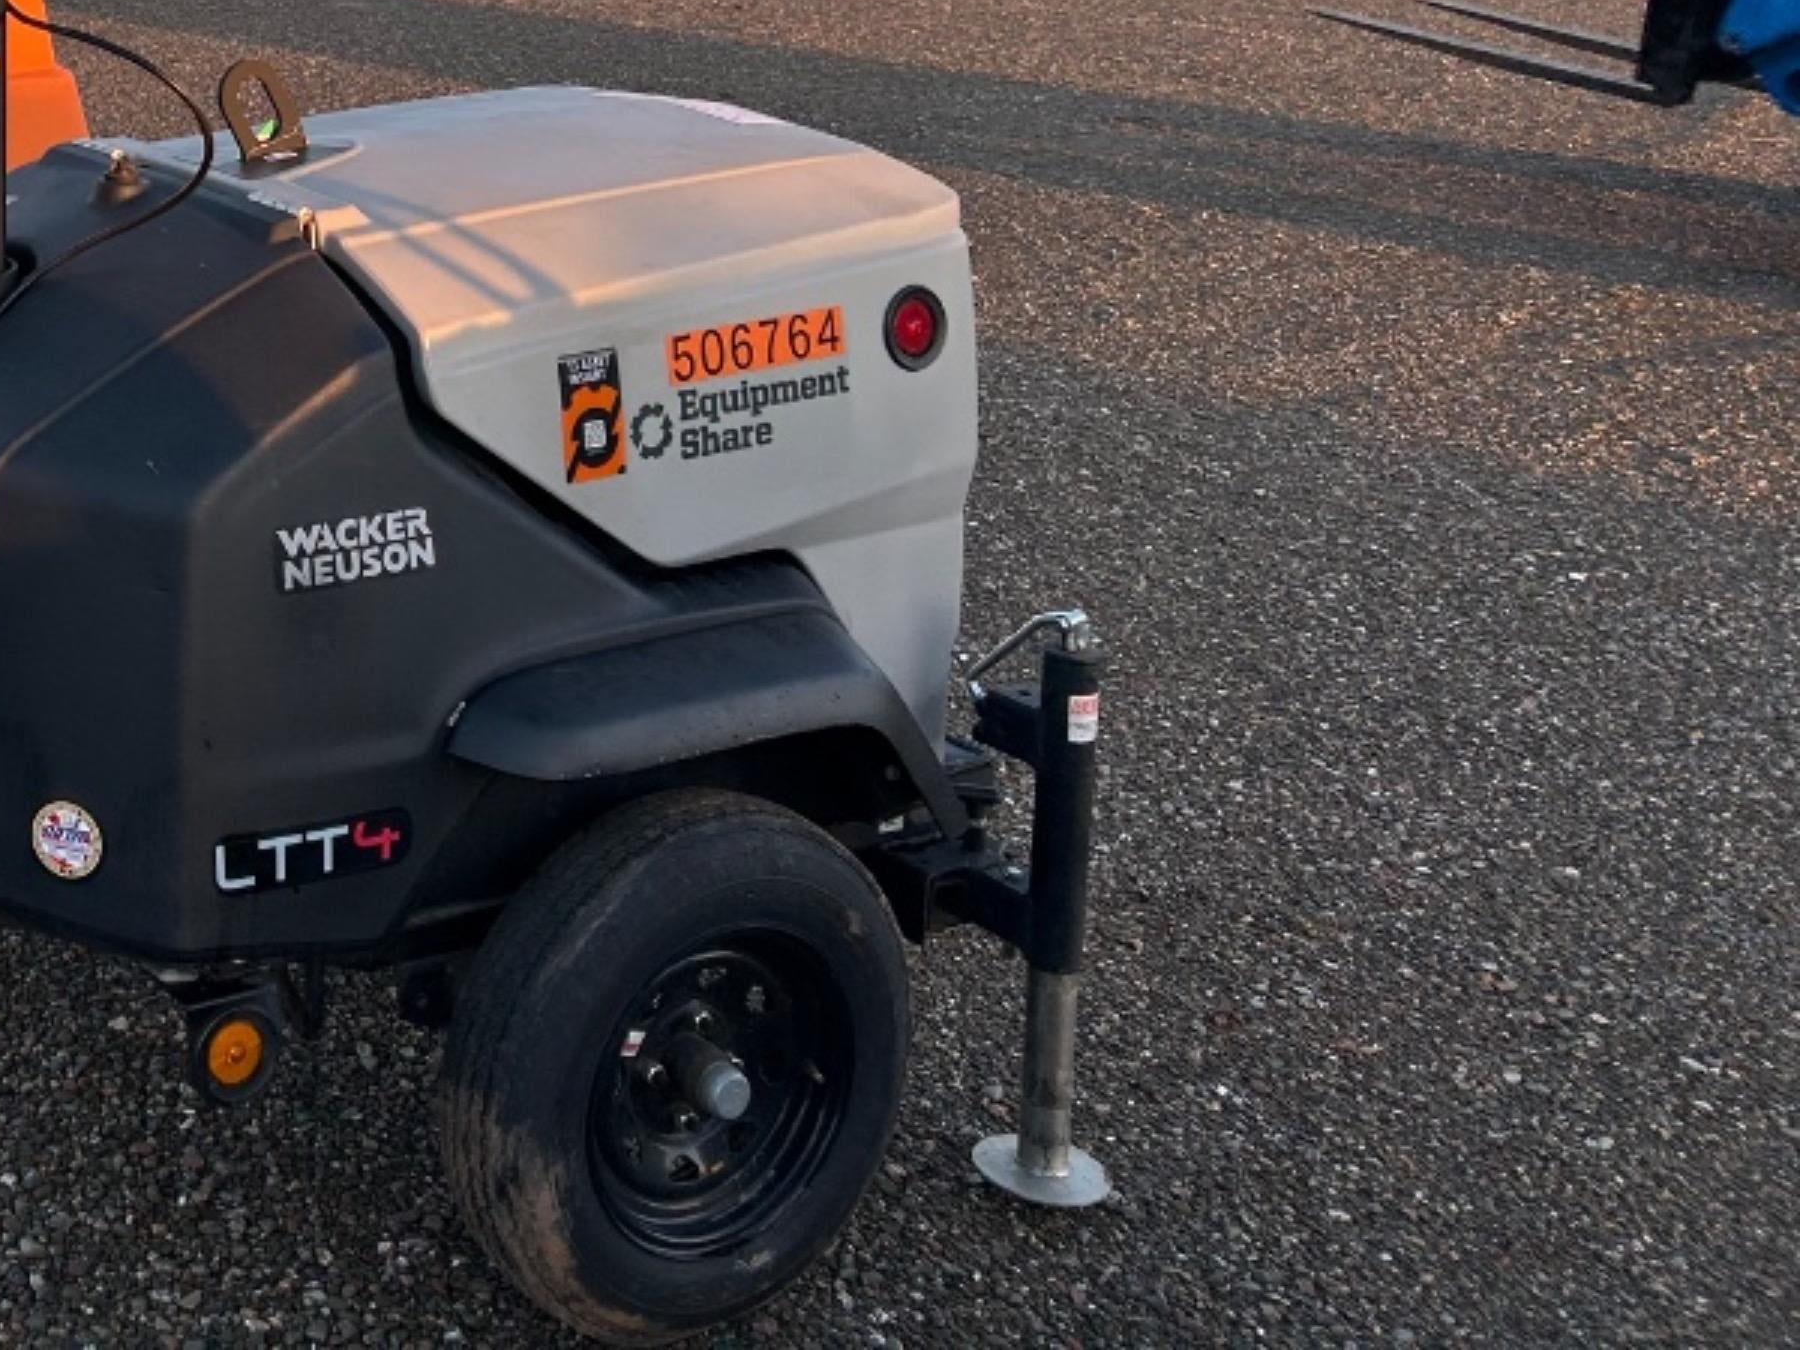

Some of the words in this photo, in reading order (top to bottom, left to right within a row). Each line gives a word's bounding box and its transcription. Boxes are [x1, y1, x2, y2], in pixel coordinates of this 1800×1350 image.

[671, 309, 840, 382] 506764
[677, 365, 850, 423] Equipment
[679, 421, 773, 461] Share
[276, 506, 433, 558] WACKER
[283, 535, 436, 591] NEUSON
